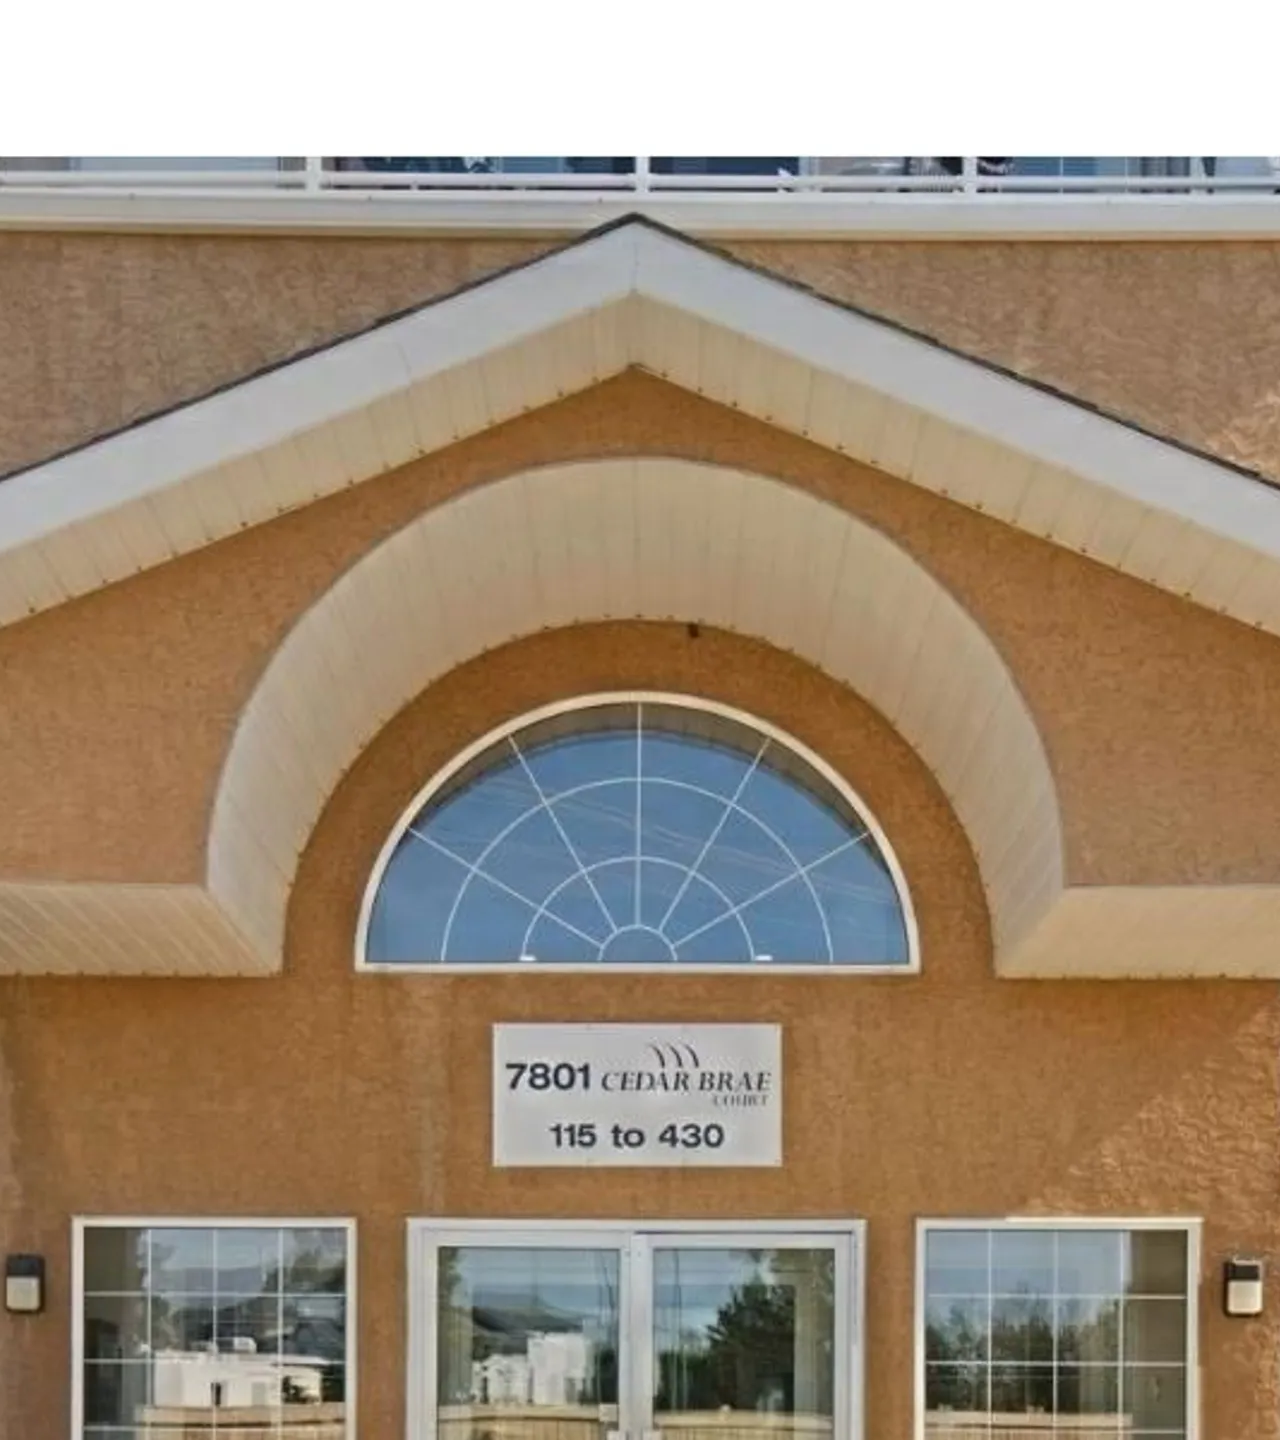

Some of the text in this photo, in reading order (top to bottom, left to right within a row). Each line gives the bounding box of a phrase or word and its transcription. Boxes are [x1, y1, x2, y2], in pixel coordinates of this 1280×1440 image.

[505, 1062, 772, 1092] 7801 CEDAR BRAE
[549, 1123, 725, 1149] 115 to 430
